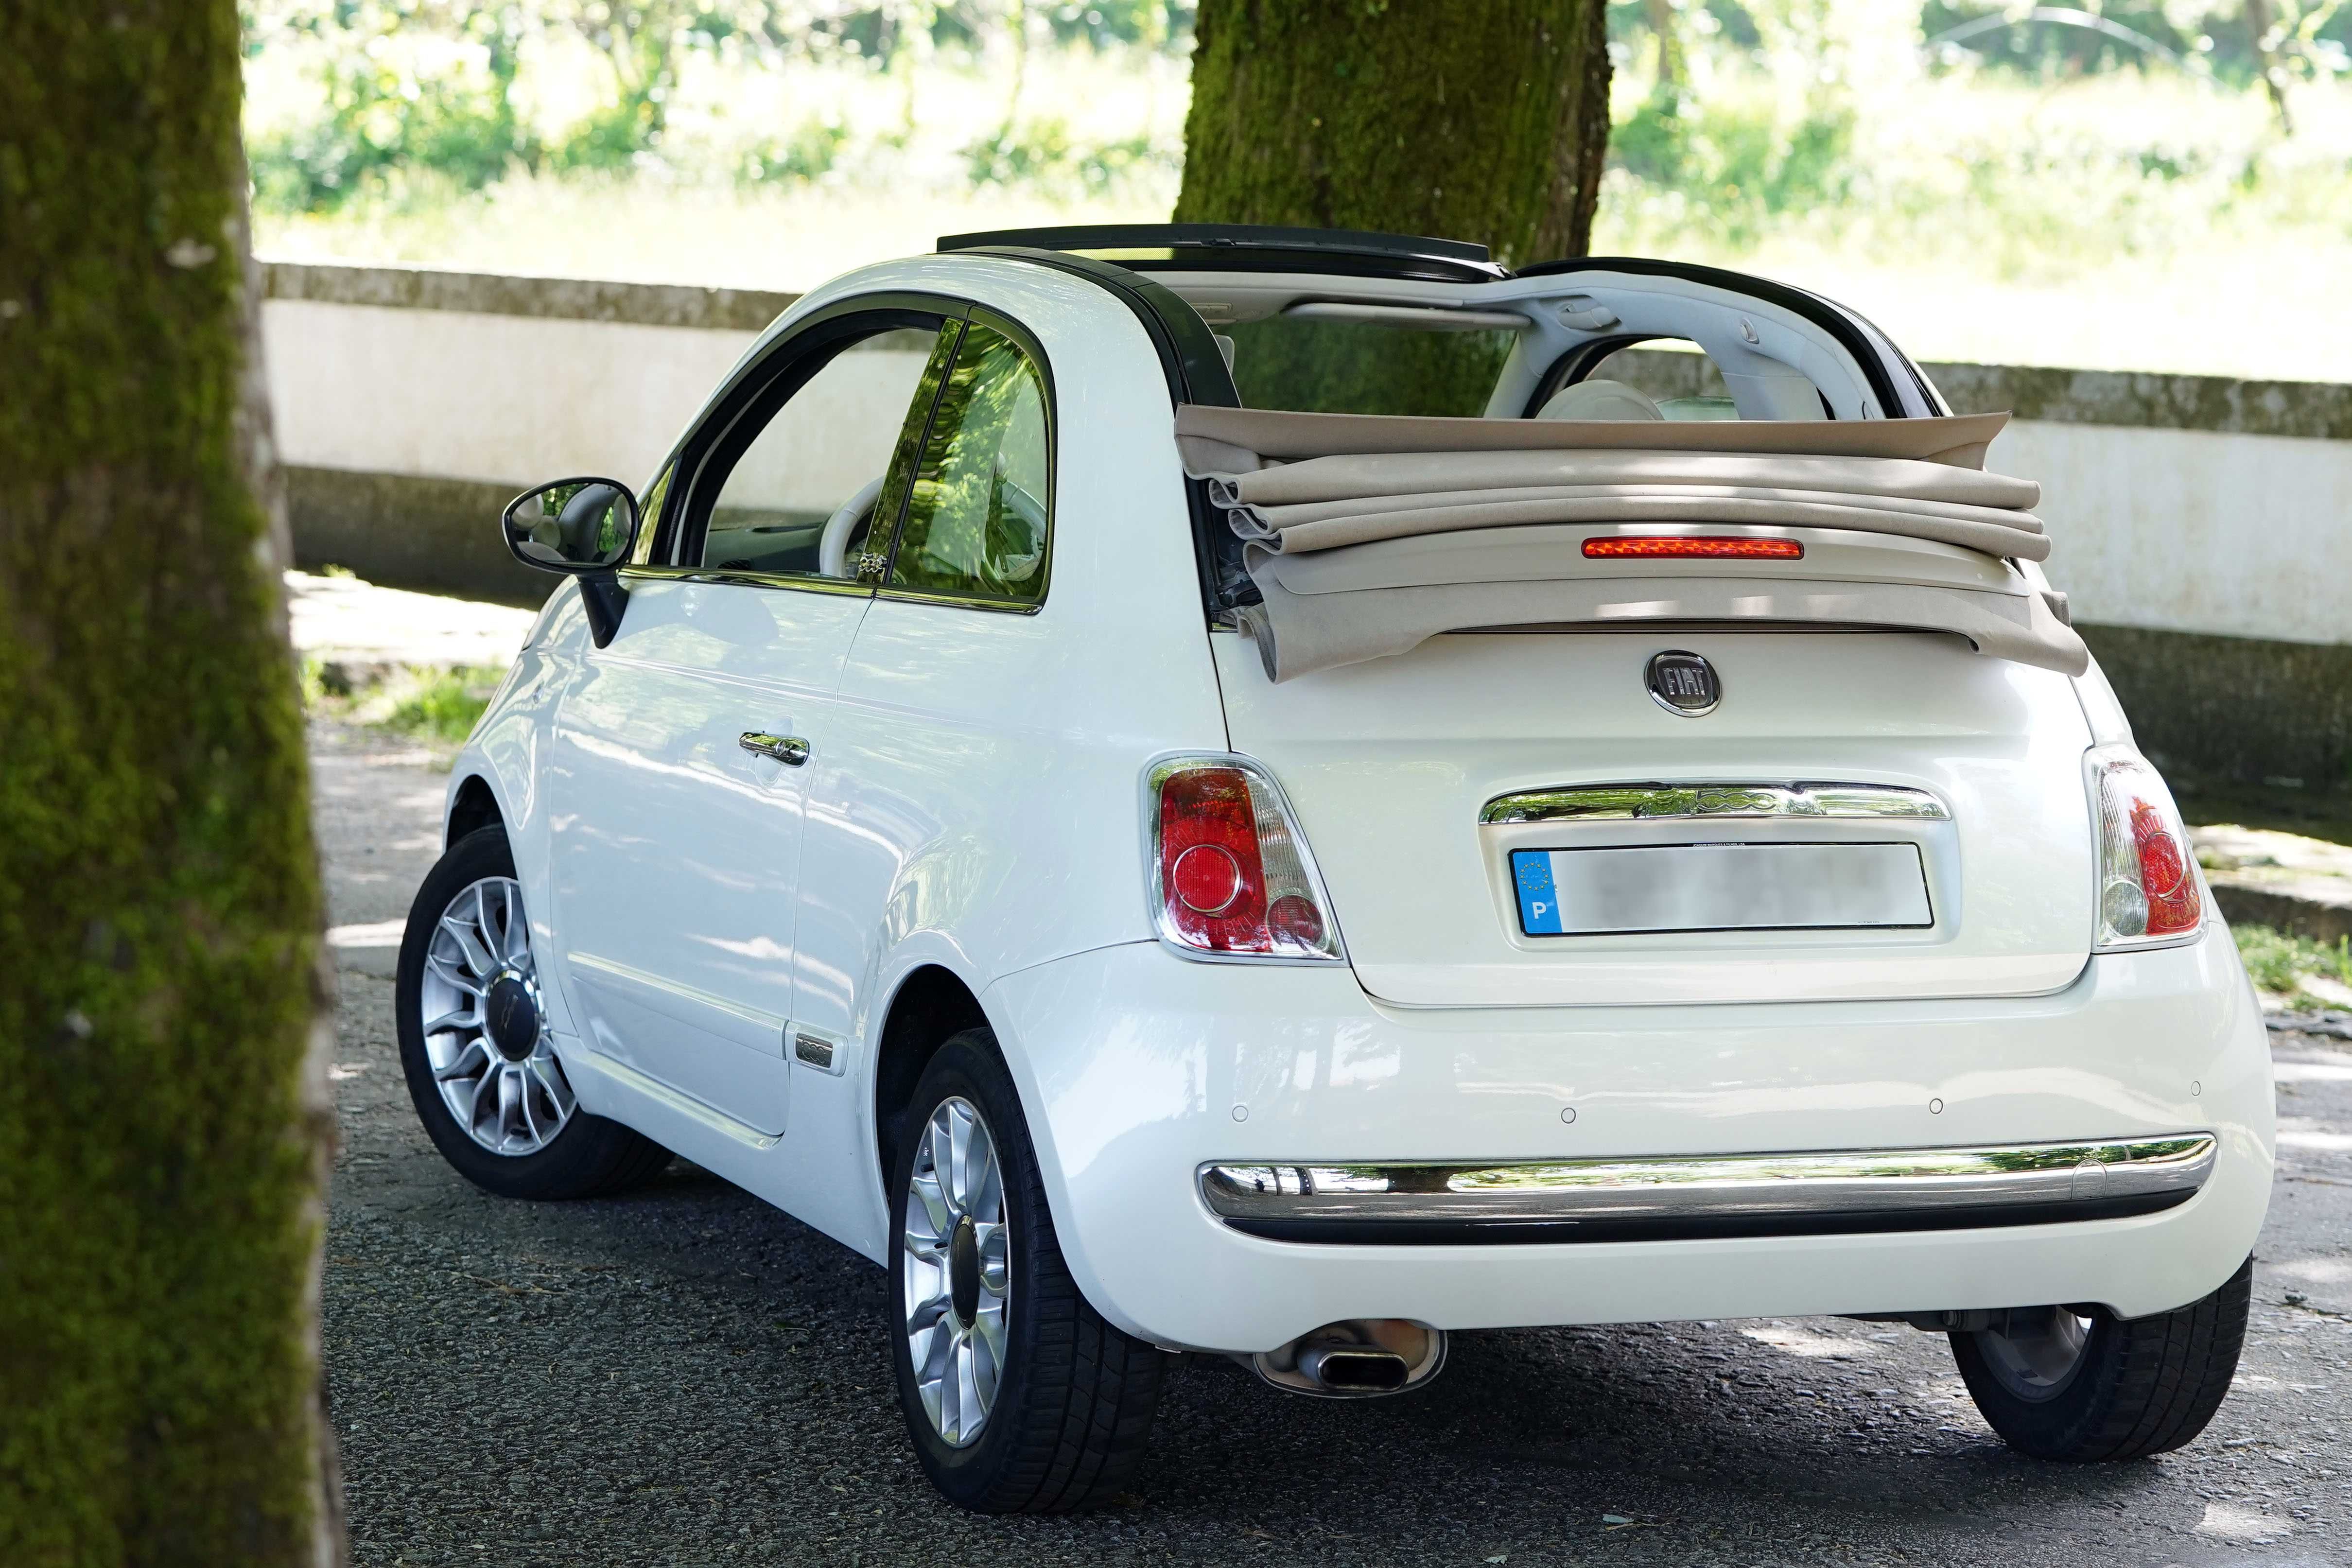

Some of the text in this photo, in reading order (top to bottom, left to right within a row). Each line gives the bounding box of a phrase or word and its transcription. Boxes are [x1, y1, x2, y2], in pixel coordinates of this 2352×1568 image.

[1663, 667, 1705, 695] FIAT
[1696, 788, 1777, 811] 500
[1532, 902, 1547, 919] P
